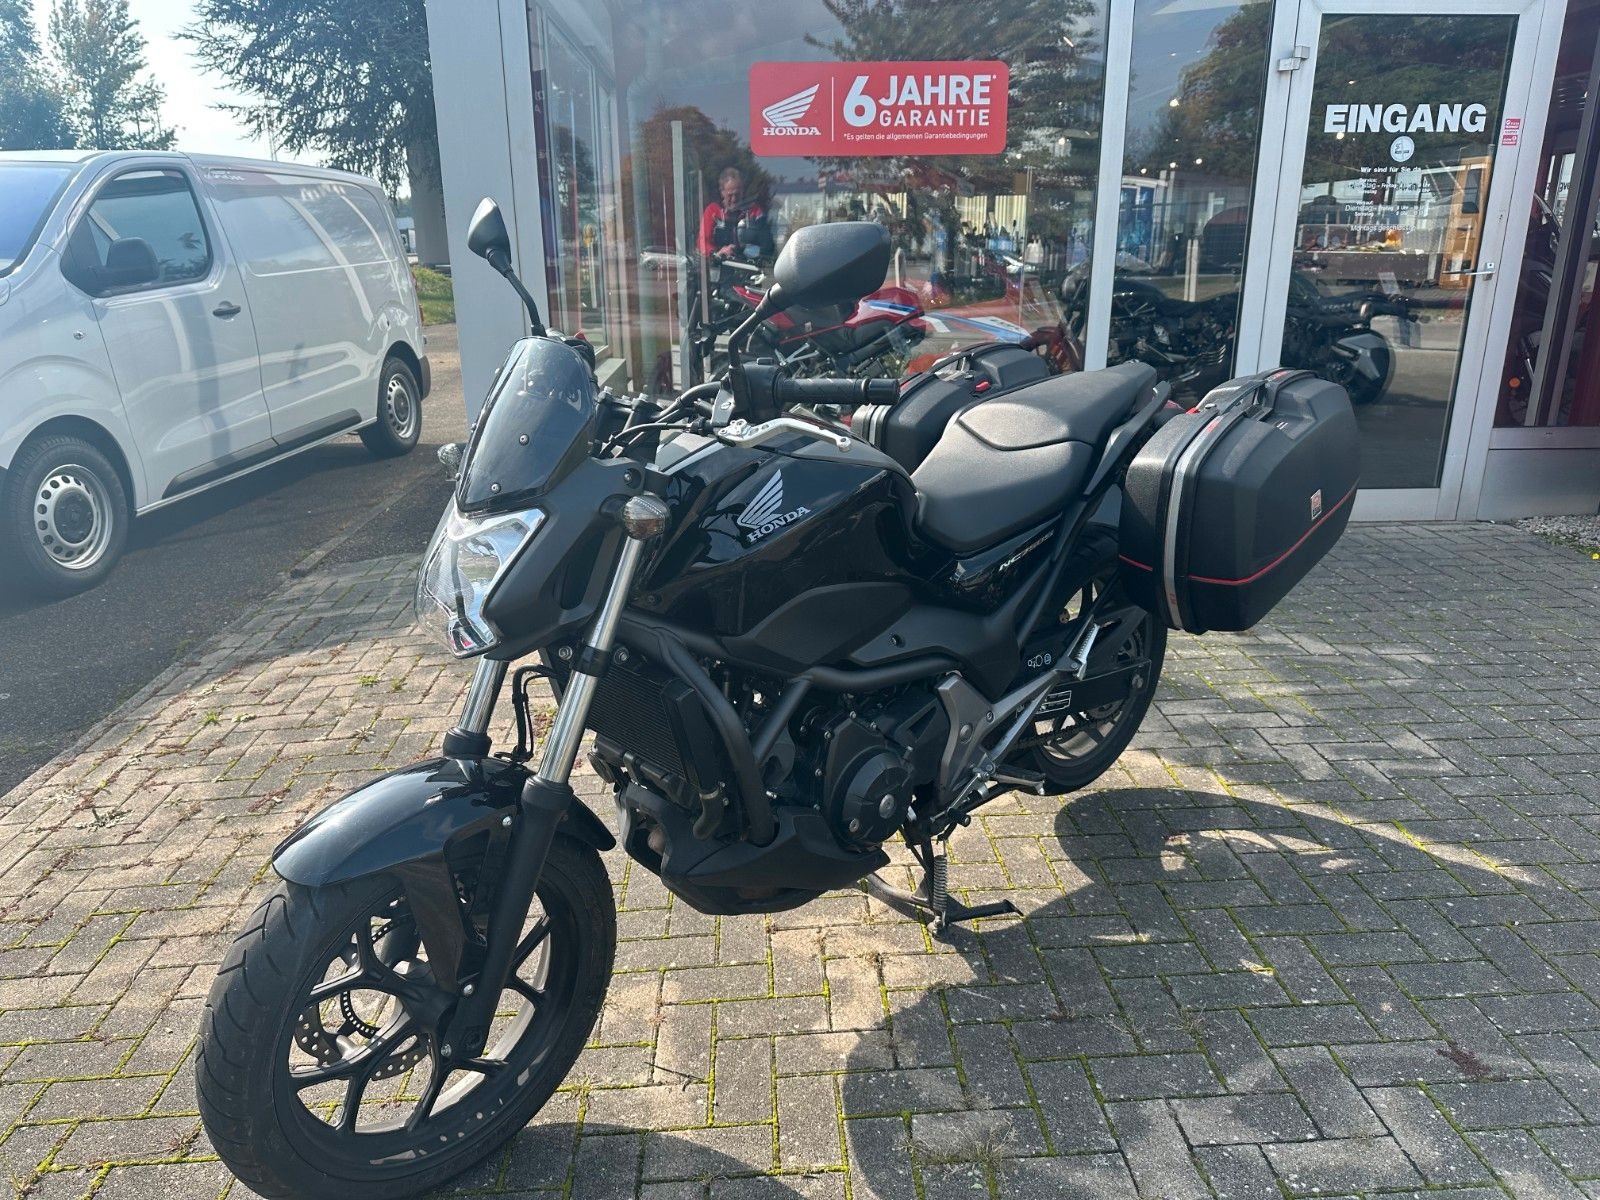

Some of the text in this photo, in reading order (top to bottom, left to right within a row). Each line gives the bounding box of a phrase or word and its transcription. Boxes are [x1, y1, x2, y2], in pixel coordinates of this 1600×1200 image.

[843, 75, 877, 127] 6
[879, 109, 990, 127] GARANTIE
[1324, 103, 1487, 133] EINGANG
[762, 127, 822, 136] HONDA
[855, 133, 874, 141] gelten
[886, 132, 922, 141] allgemeinen
[924, 132, 988, 141] Garantiebedingungen
[746, 506, 811, 542] HONDA
